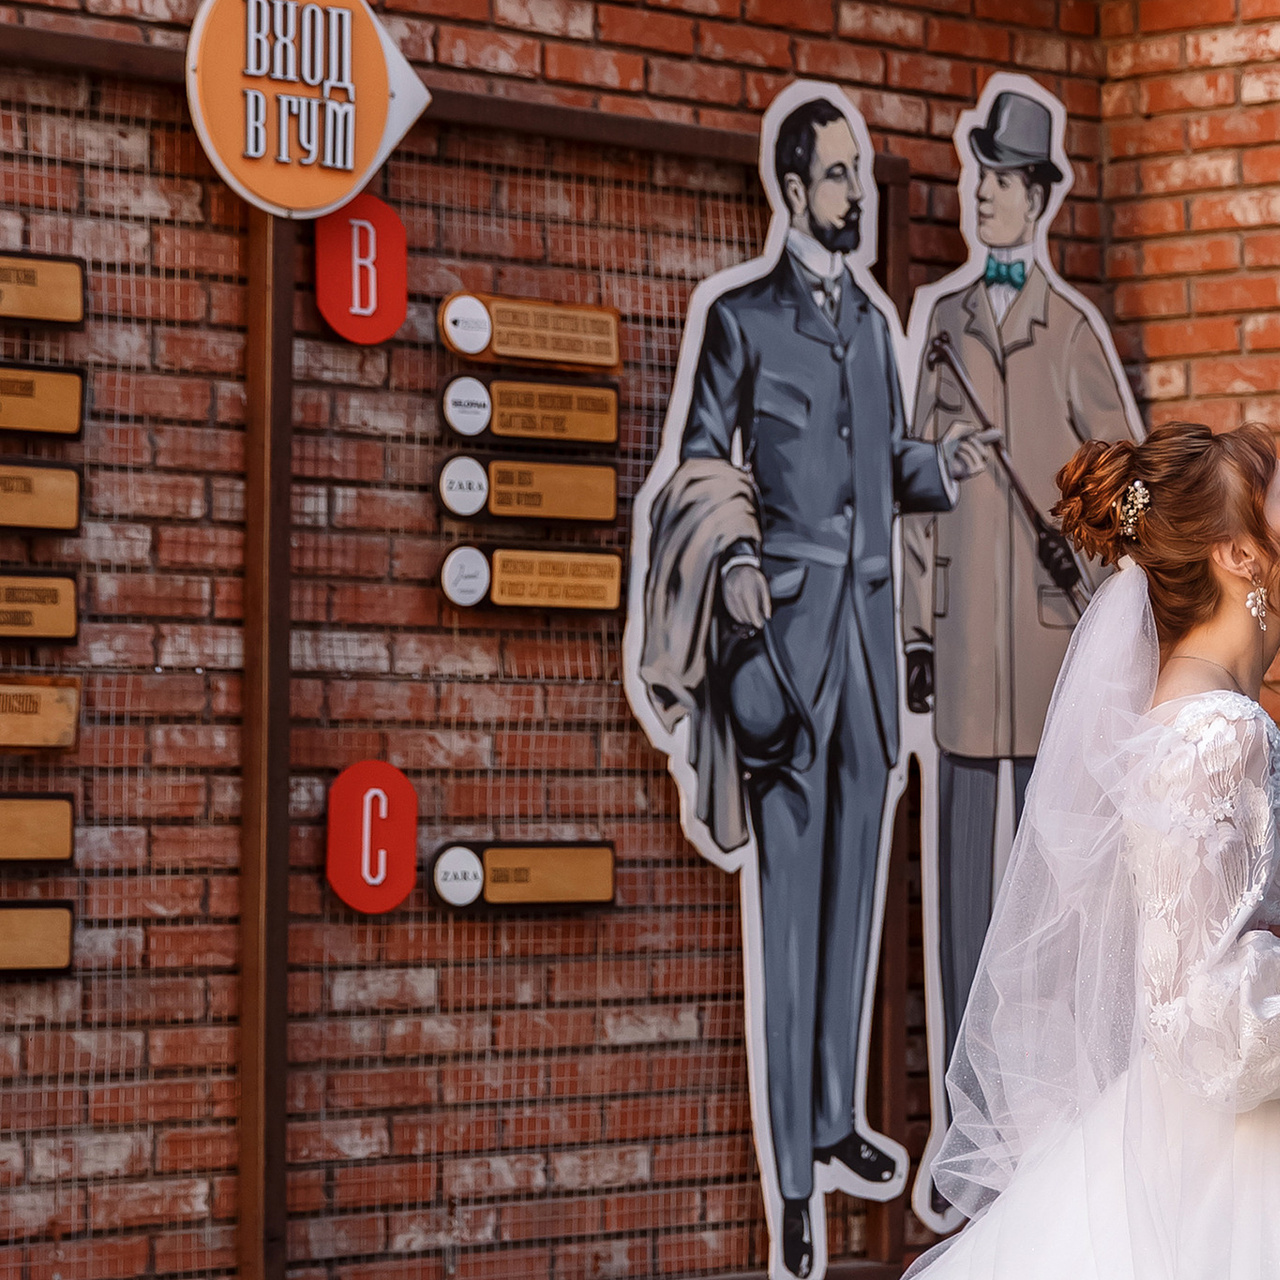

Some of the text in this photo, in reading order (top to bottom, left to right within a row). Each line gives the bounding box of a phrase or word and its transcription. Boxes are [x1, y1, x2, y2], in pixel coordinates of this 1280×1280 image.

[243, 89, 355, 172] В ГУМ
[440, 870, 481, 882] ZARA
